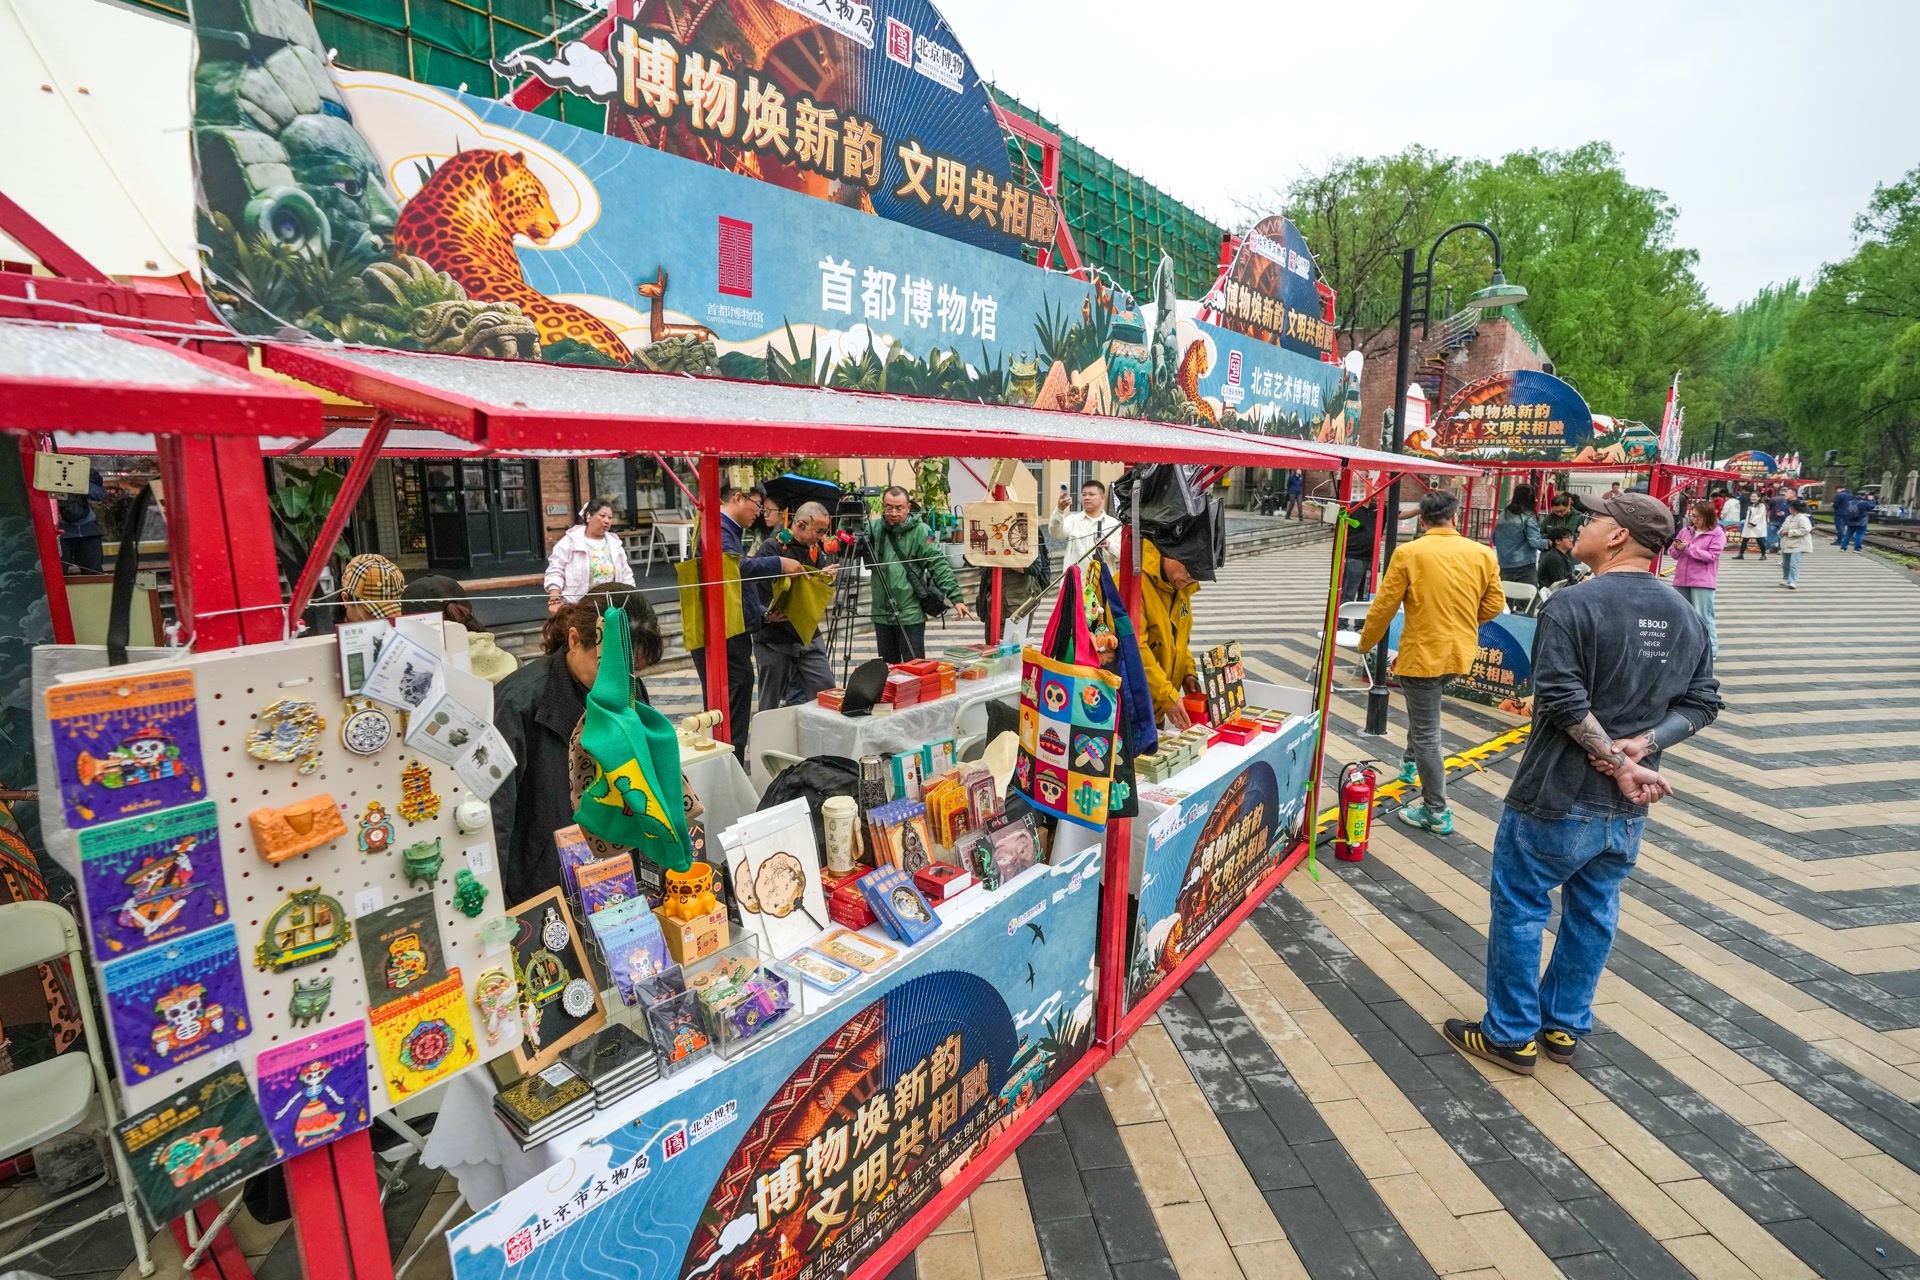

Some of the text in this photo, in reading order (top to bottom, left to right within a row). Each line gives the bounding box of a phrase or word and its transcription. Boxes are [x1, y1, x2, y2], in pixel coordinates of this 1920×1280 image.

[796, 3, 831, 23] Administration
[836, 23, 854, 36] Cultural
[854, 32, 873, 47] Heritage
[803, 0, 873, 34] 文物局
[917, 39, 964, 75] 北京博物
[617, 24, 1057, 244] 博物焕新韵 文明共相融
[706, 302, 765, 323] 首都博物馆
[818, 255, 998, 342] 首都博物馆
[1225, 280, 1334, 351] 博物焕新韵 文明共相融
[707, 315, 764, 329] CAPITAL MUSEUM CHINA
[1250, 366, 1320, 408] 北京艺术博物馆
[1470, 404, 1551, 420] 博物焕新韵
[1482, 420, 1565, 436] 文明共相融
[1638, 618, 1668, 629] BE BOLD
[1472, 661, 1515, 686] 共相融
[1200, 802, 1264, 878] 博物焕新韵
[1208, 825, 1269, 901] 文明共相融
[691, 1101, 736, 1133] 北京博物
[752, 1033, 962, 1230] 博物焕新韵
[806, 1058, 989, 1252] 文明共相融
[534, 1154, 648, 1237] 北京市文物局
[852, 1234, 869, 1252] FILM
[869, 1207, 898, 1234] FESTIVAL
[899, 1183, 926, 1209] MUSEUM
[931, 1152, 959, 1179] CULTURAL
[959, 1124, 988, 1153] CREATIVITY
[988, 1106, 1008, 1127] MARKET
[554, 1217, 576, 1233] Municipal
[577, 1196, 609, 1217] Administration
[614, 1182, 631, 1193] Cultural
